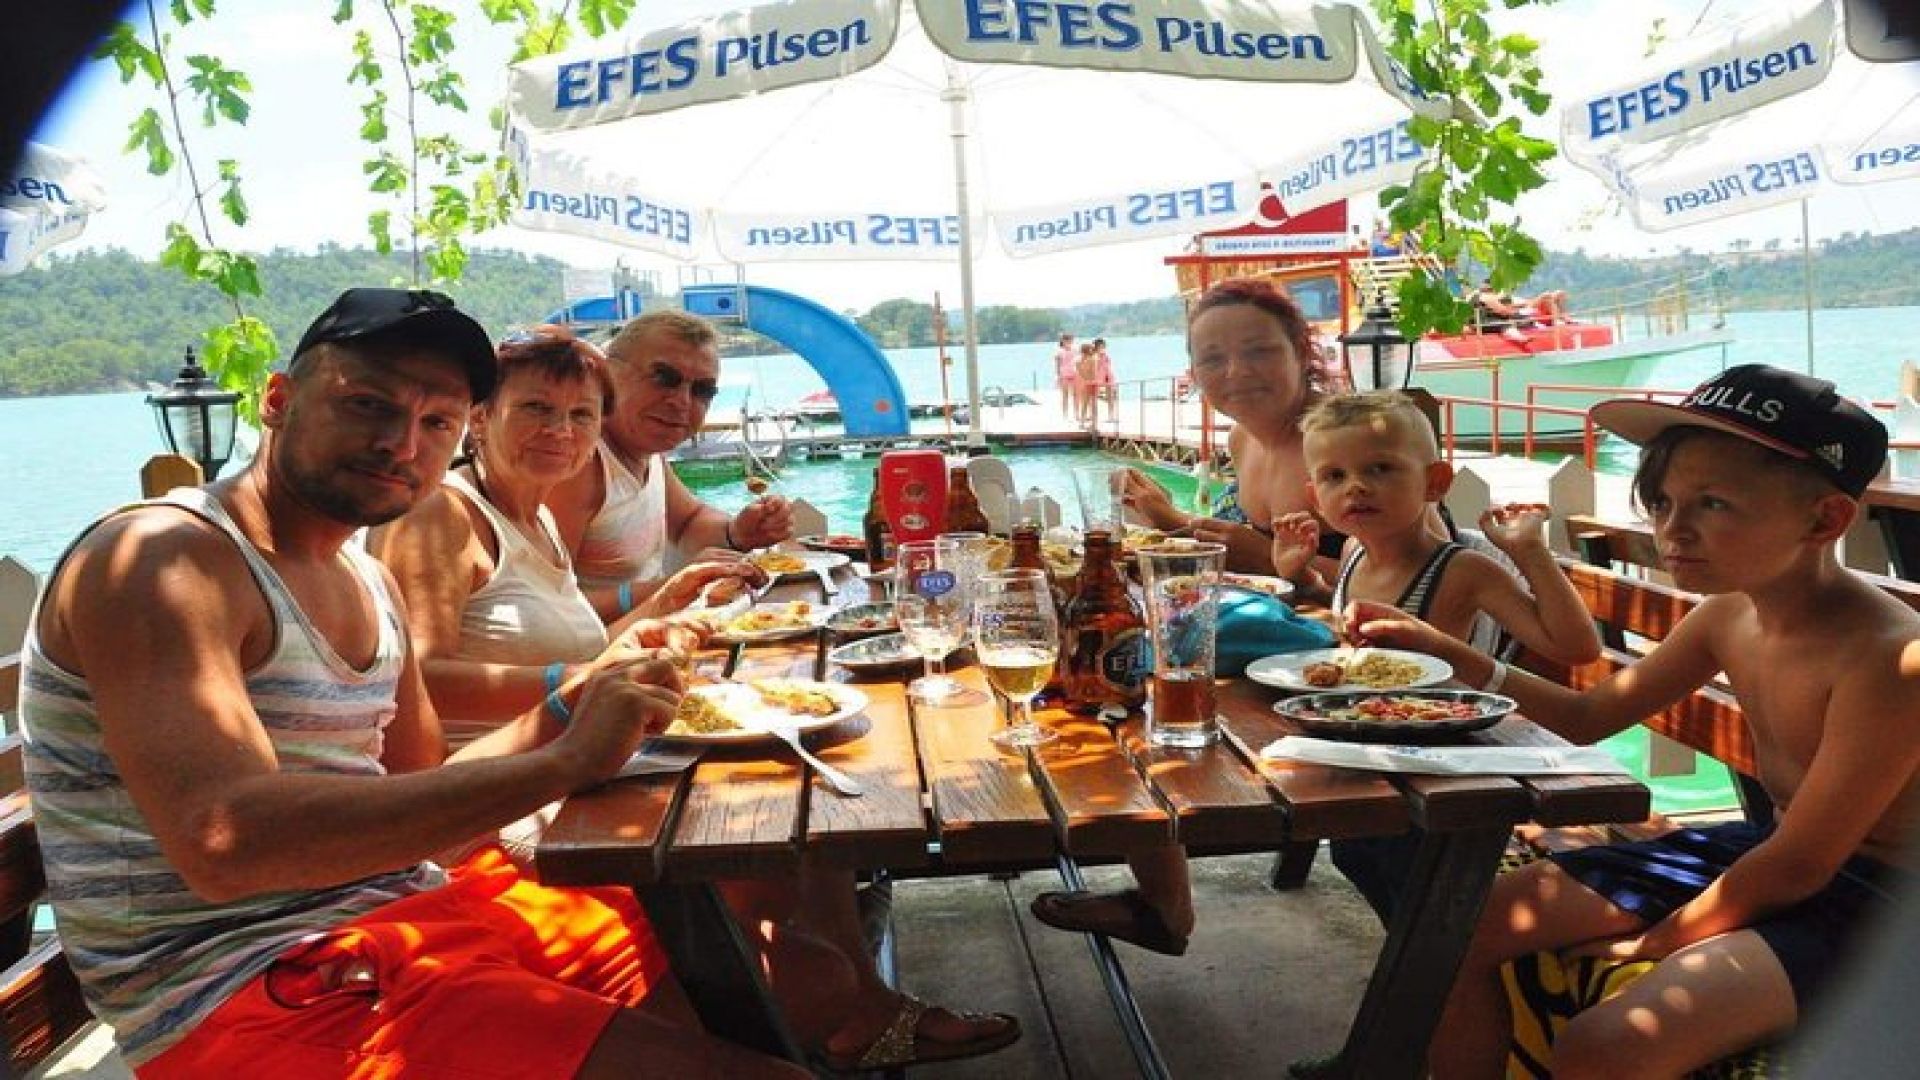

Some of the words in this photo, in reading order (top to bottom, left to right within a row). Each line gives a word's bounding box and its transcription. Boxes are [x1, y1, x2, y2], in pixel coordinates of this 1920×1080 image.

[555, 35, 698, 109] EFES
[714, 18, 871, 77] Pilsen
[966, 0, 1142, 49] EFES
[1156, 17, 1332, 61] Pilsen
[1588, 69, 1689, 140] EFES
[1699, 41, 1816, 101] Pilsen
